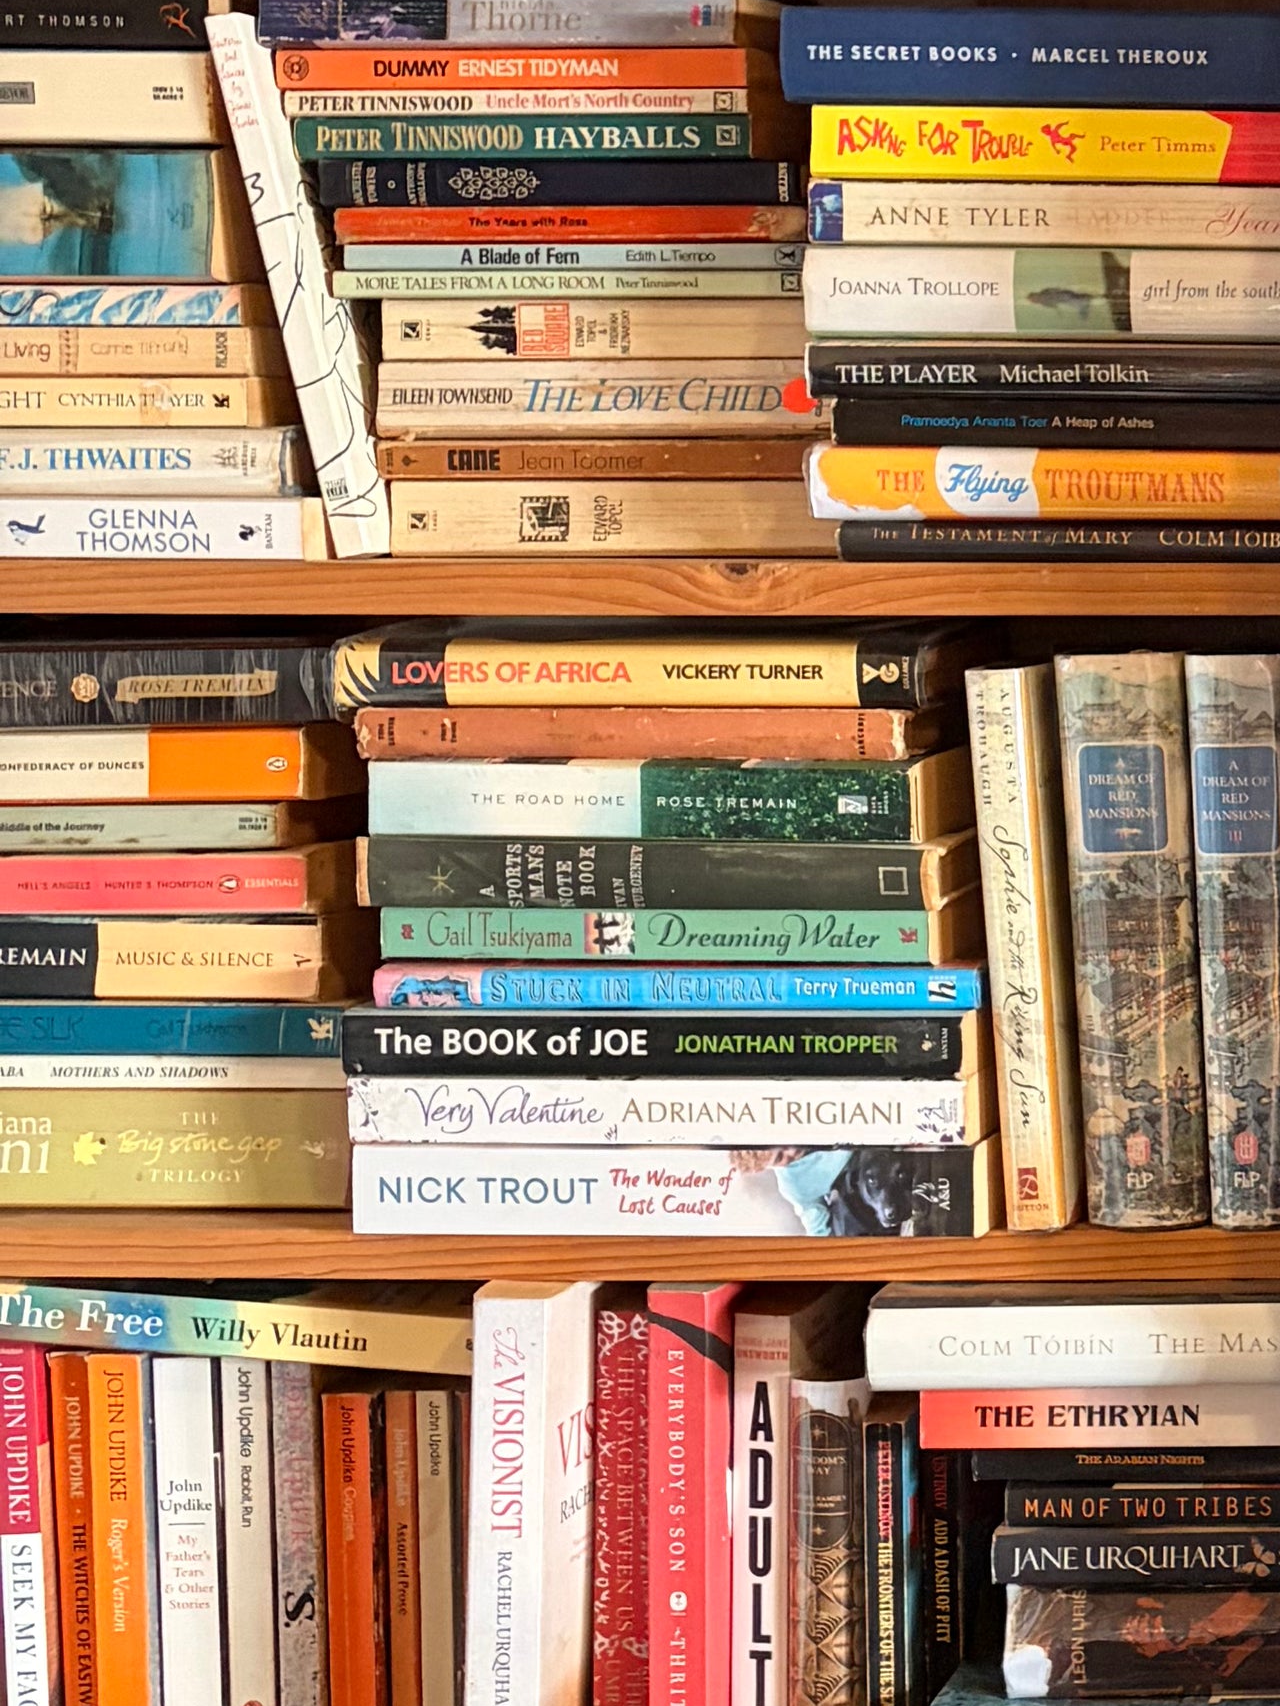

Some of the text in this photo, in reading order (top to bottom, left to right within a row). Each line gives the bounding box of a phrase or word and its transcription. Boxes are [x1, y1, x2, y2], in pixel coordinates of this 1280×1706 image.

[807, 45, 1209, 64] THE SECRET BOOKS MARCEL THEROUX
[373, 59, 618, 78] DUMMY ERNEST TIDYMAN
[836, 363, 1149, 383] THE PLAYER Michael Tolkin
[88, 509, 198, 531] GLENNA
[76, 531, 211, 553] THOMSON
[375, 1027, 647, 1056] The BOOK of JOE
[675, 1034, 898, 1055] JONATHAN TROPPER
[380, 1178, 598, 1205] NICK TROUT
[192, 1315, 369, 1354] Willy Vlautin
[975, 1404, 1200, 1428] THE ETHRYIAN
[491, 1375, 523, 1537] VISIONIST
